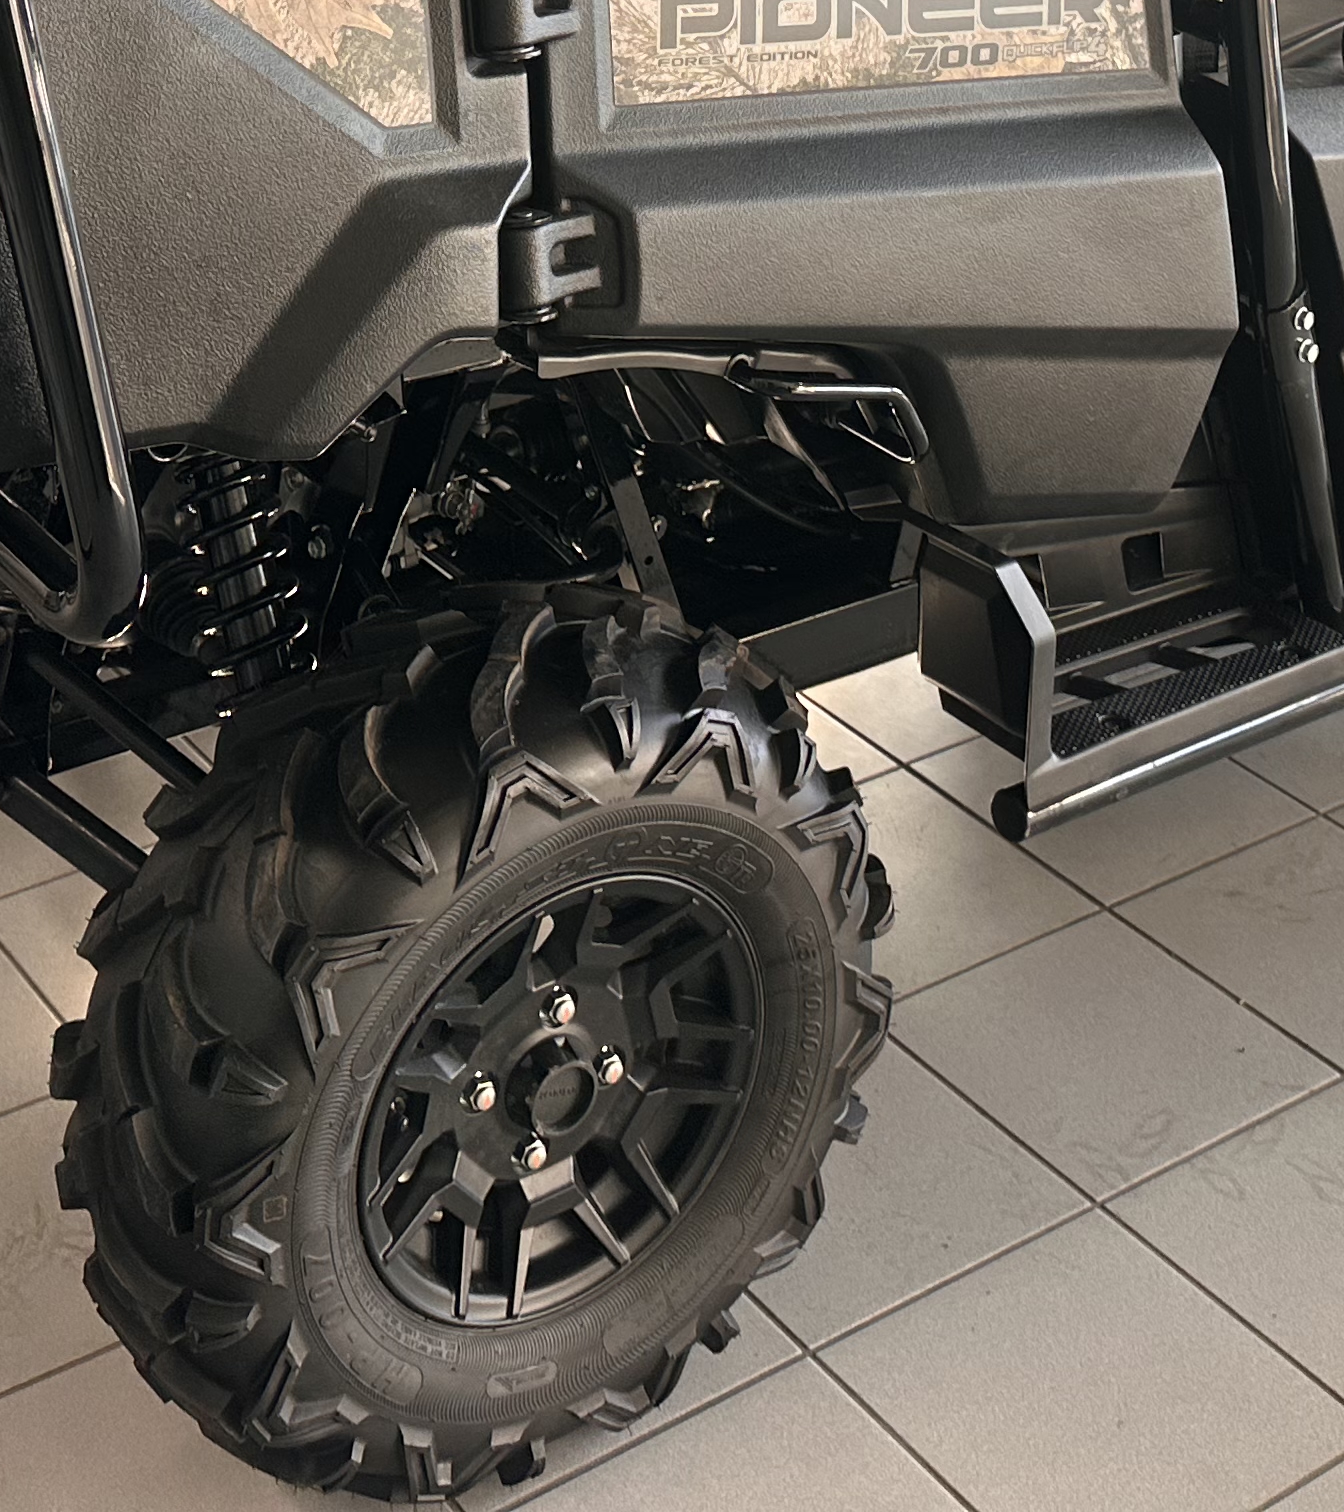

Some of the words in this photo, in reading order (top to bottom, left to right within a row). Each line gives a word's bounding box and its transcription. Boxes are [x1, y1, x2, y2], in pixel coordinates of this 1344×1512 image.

[657, 54, 736, 68] FOREST
[746, 49, 819, 63] EDITION
[906, 41, 1001, 73] 700
